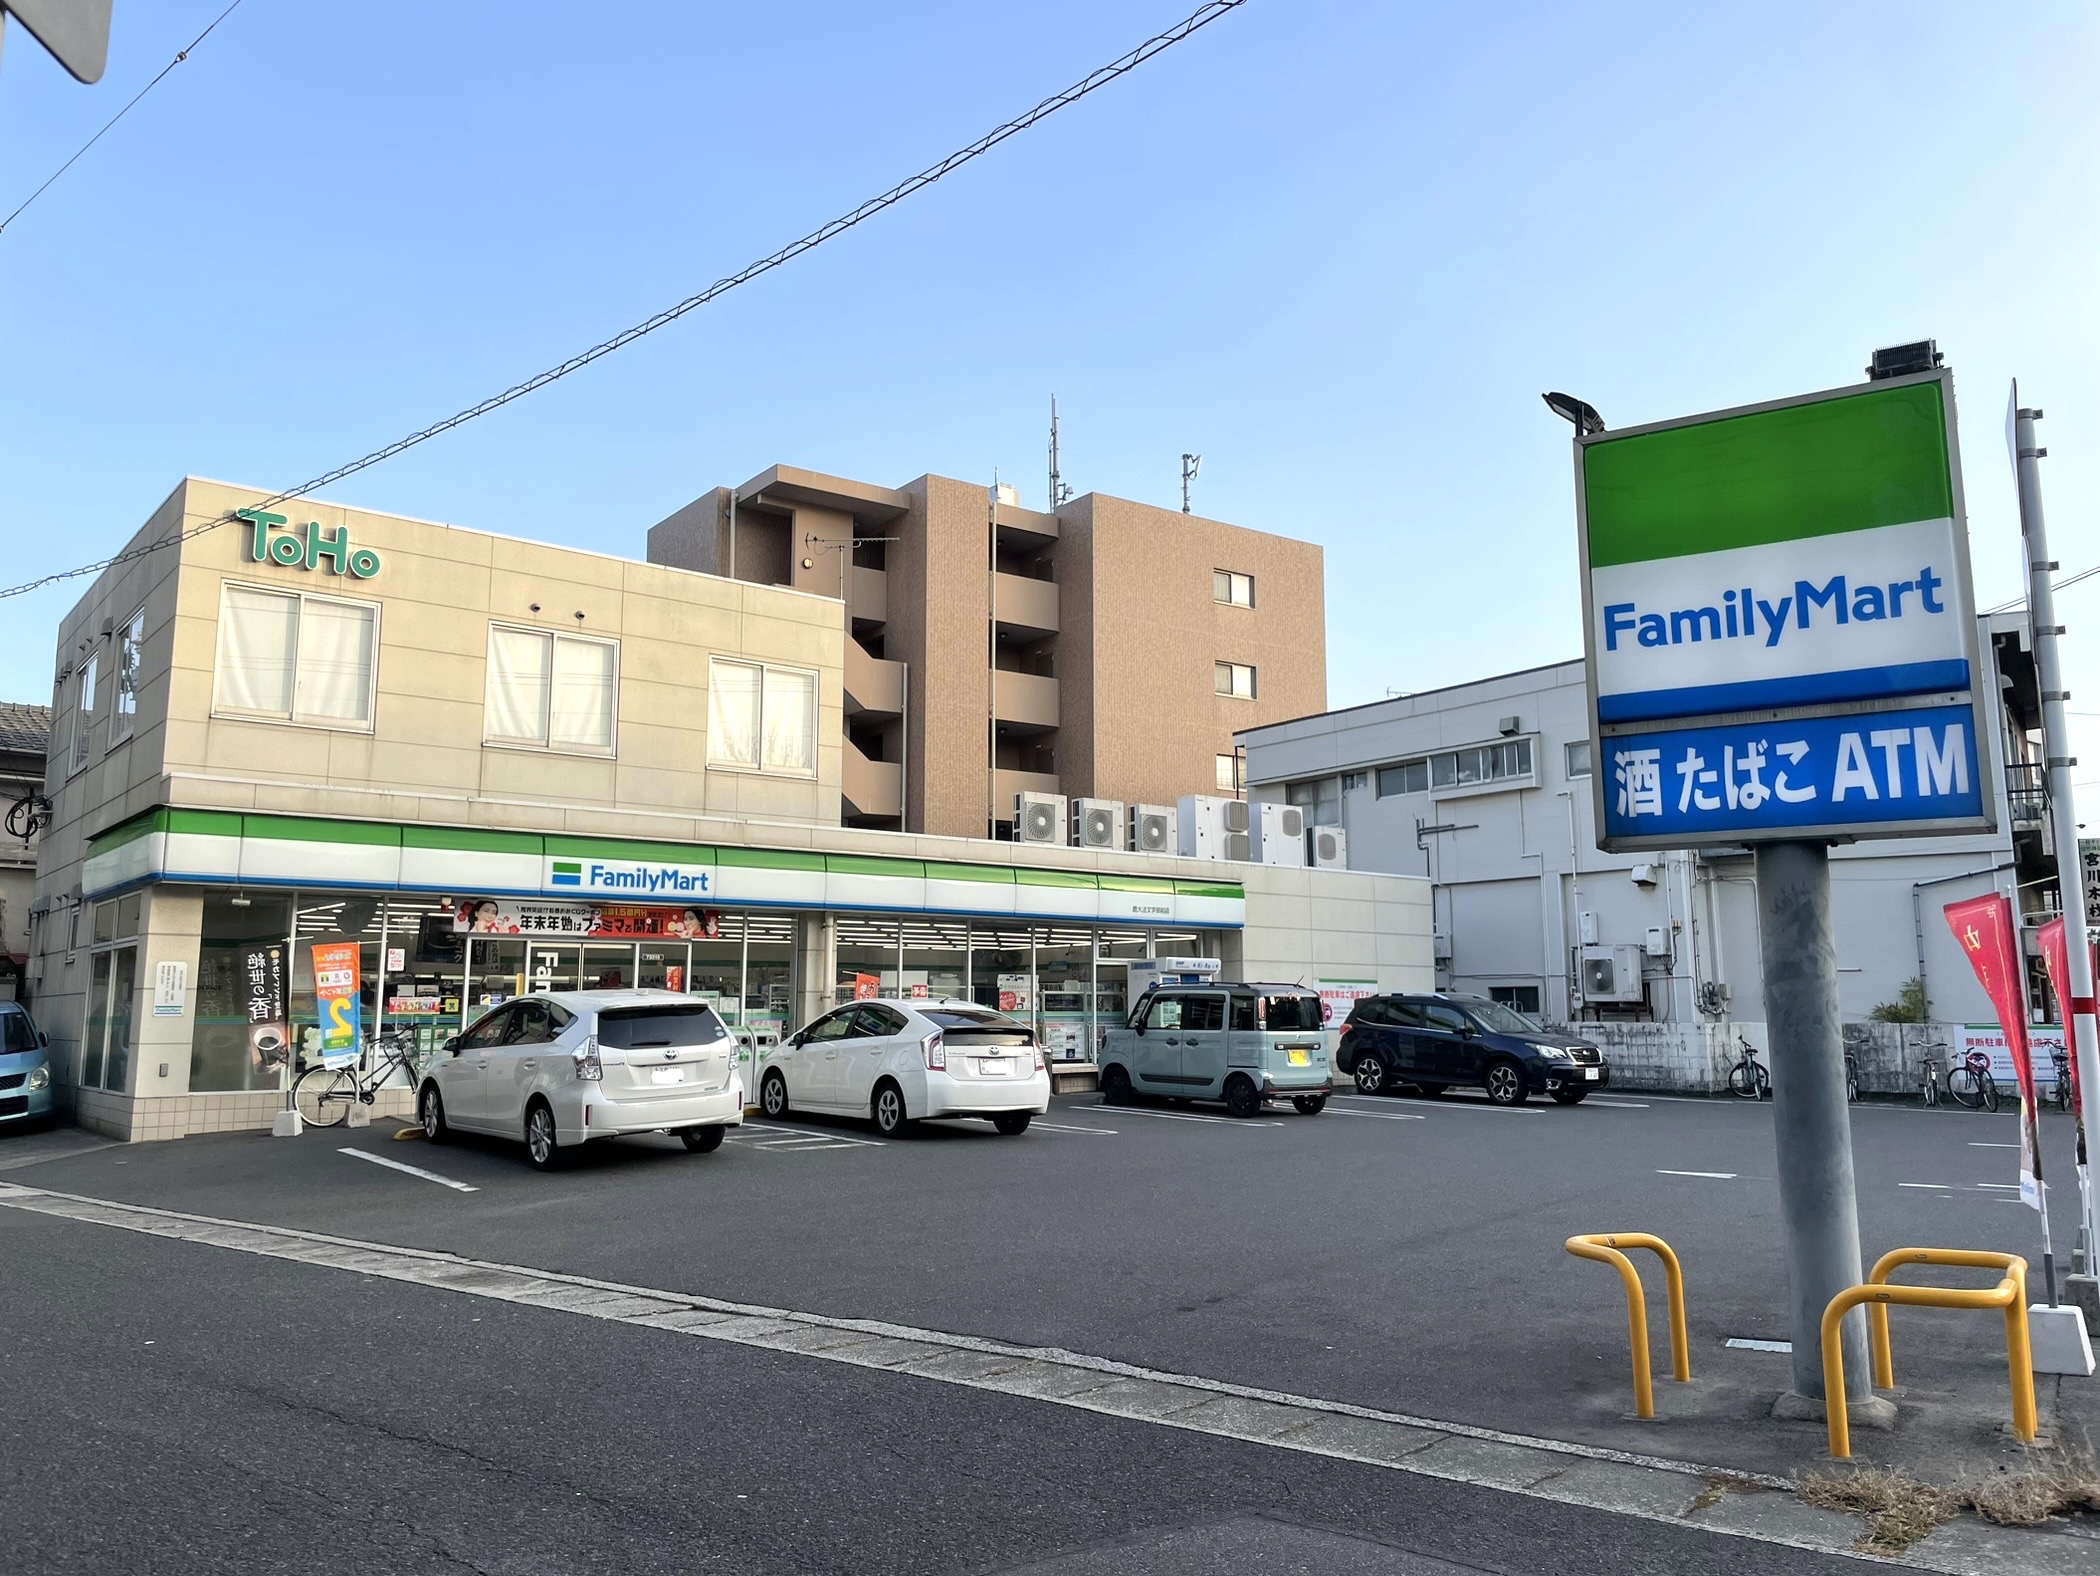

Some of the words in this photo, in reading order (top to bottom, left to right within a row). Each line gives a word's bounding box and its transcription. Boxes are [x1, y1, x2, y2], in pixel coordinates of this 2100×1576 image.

[1603, 566, 1945, 652] FamilyMart
[1615, 748, 1663, 818] 酒
[1675, 738, 1817, 814] たばこ
[1831, 723, 1970, 803] ATM
[590, 865, 709, 892] FamilyMart
